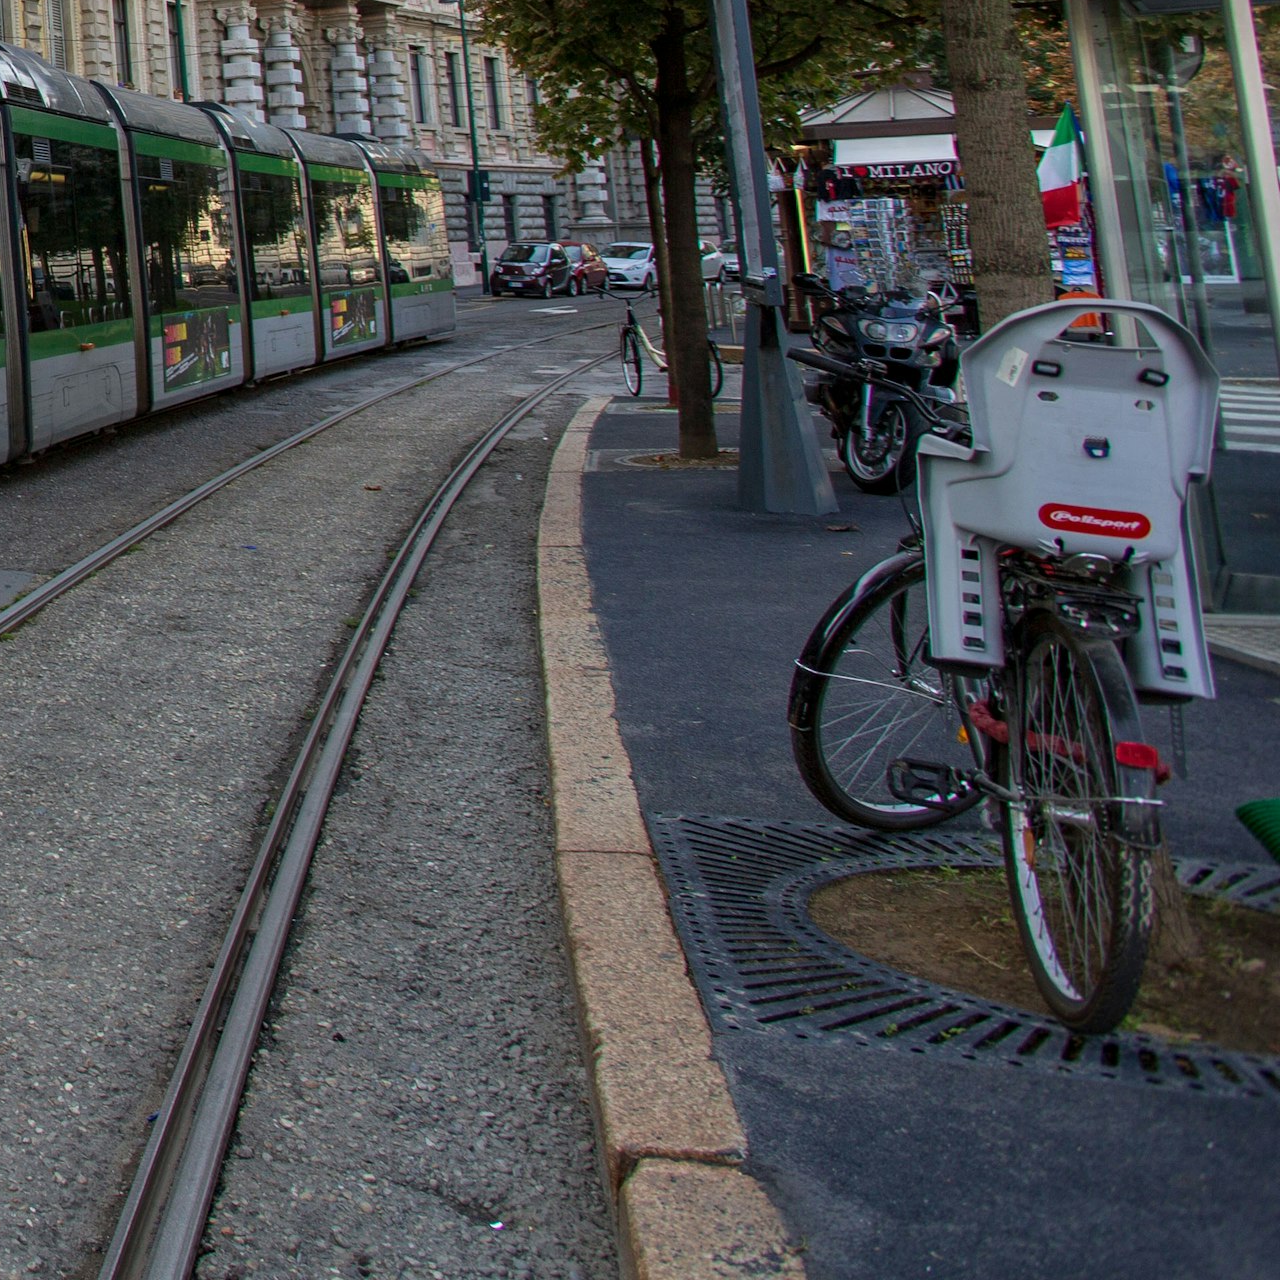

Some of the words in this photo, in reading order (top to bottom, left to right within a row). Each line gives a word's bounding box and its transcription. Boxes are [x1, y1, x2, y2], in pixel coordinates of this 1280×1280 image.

[842, 166, 853, 177] I
[867, 162, 953, 178] MILANO
[1050, 510, 1140, 530] Polisport
